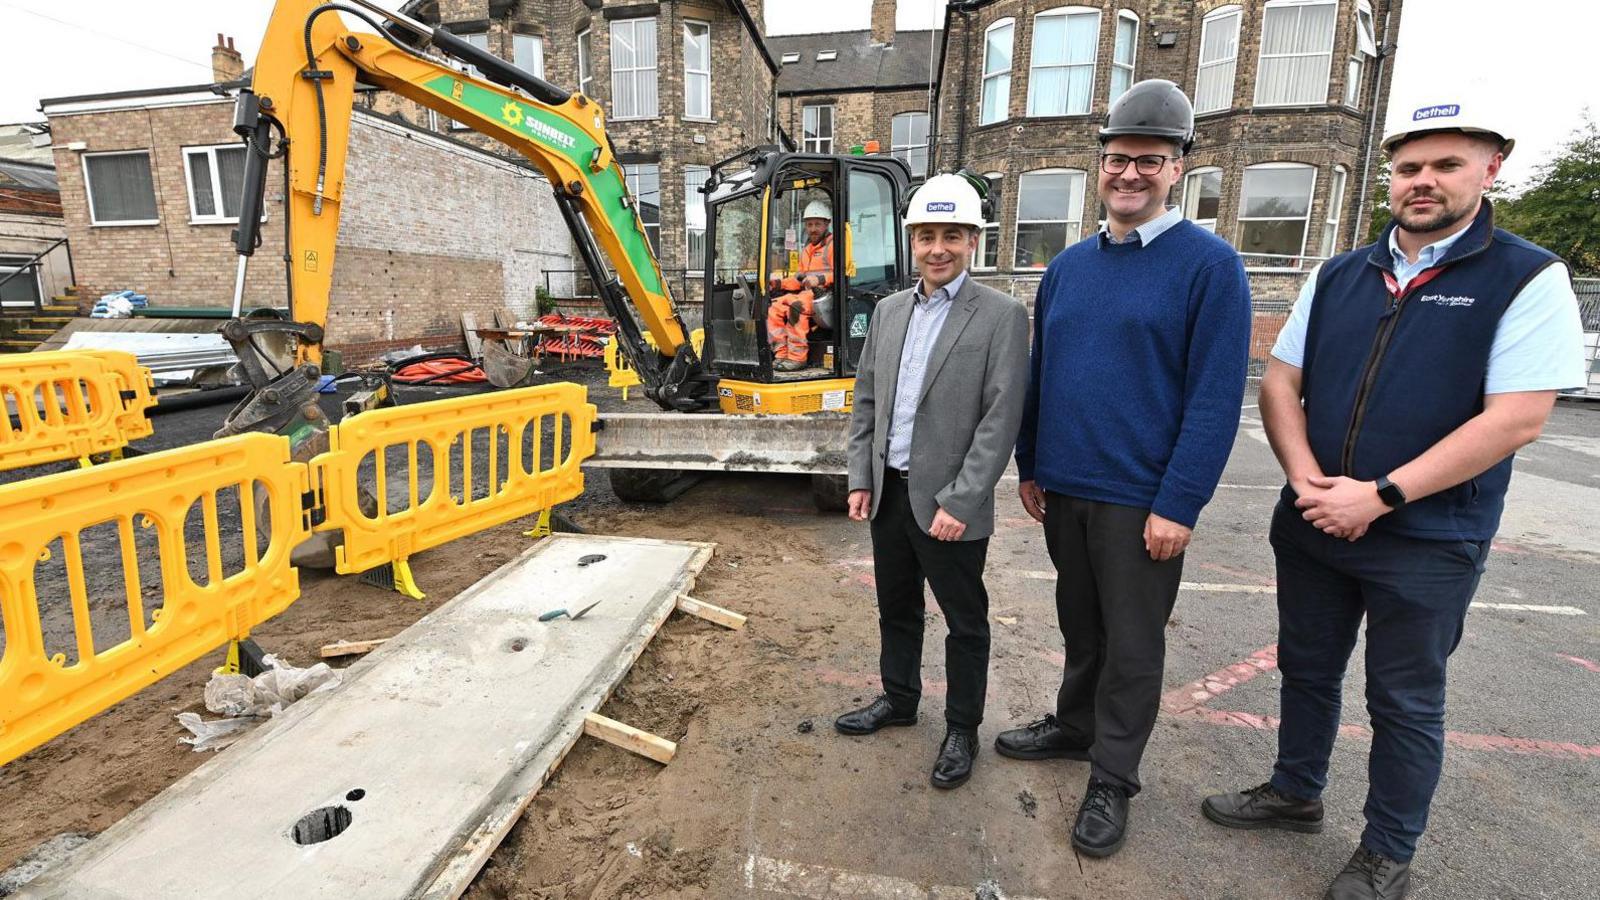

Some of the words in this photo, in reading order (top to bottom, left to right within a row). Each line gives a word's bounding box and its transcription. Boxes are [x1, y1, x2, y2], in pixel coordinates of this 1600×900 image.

[1415, 106, 1457, 119] bethell
[525, 115, 576, 147] SUNBELT
[928, 203, 954, 211] bethell
[1438, 294, 1475, 304] Yorkshire
